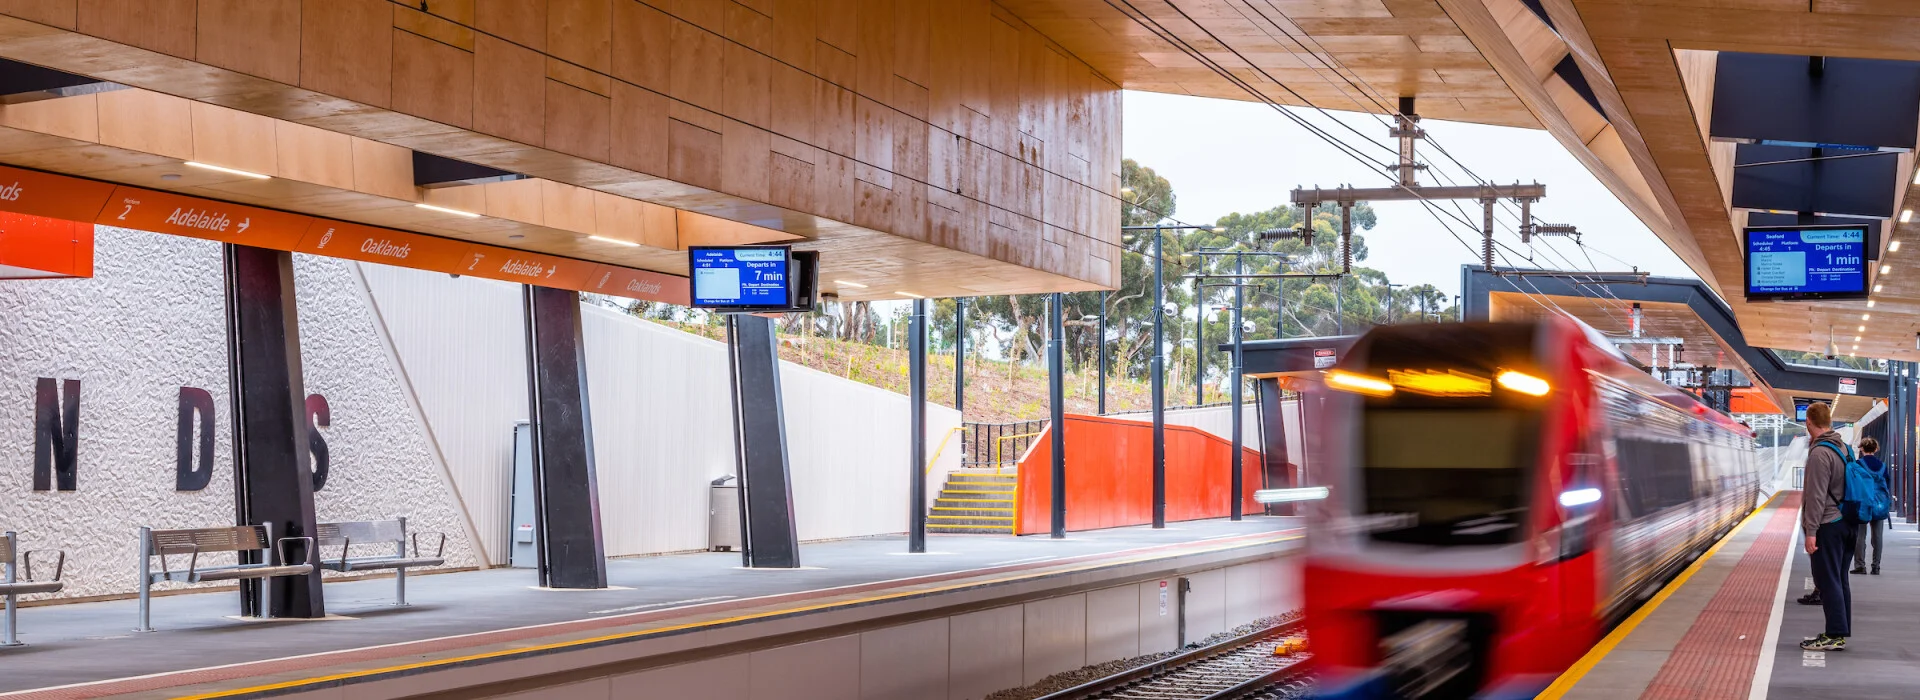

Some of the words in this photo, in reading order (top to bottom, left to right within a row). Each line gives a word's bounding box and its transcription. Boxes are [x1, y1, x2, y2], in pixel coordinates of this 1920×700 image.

[117, 204, 132, 220] 2
[165, 207, 230, 232] Adelaide
[360, 238, 411, 259] Oaklands
[468, 257, 479, 270] 2
[1825, 253, 1832, 265] 1
[1836, 254, 1860, 265] min
[499, 259, 543, 277] Adelaide
[754, 270, 762, 281] 7
[763, 271, 783, 281] min
[627, 278, 662, 294] Oaklands
